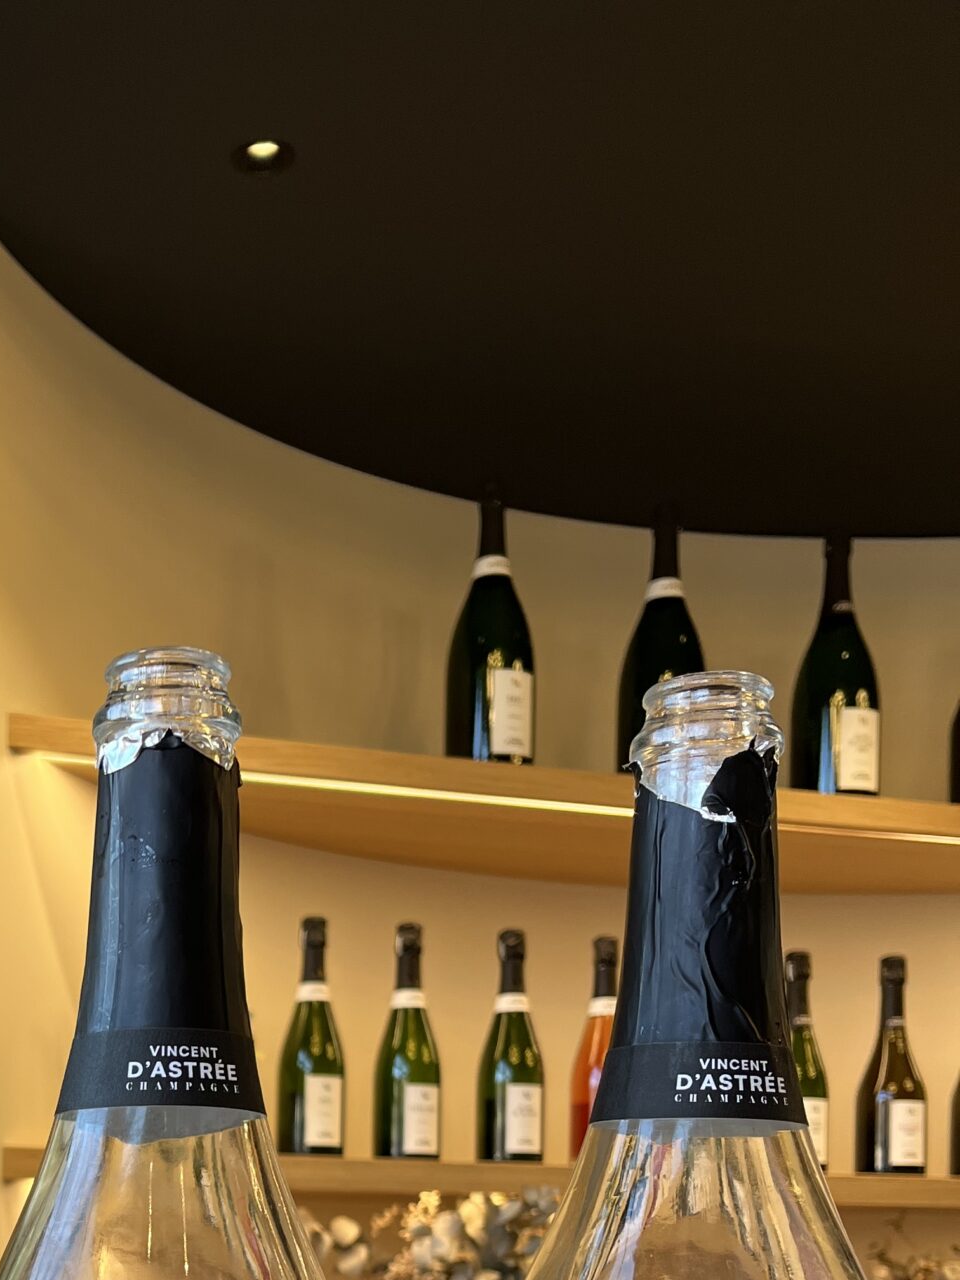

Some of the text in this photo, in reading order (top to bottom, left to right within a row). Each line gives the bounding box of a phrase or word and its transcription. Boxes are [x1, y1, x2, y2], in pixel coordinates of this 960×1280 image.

[149, 1045, 218, 1059] VINCENT
[127, 1059, 238, 1081] D'ASTRÉE
[699, 1058, 768, 1072] VINCENT
[125, 1081, 240, 1094] CHAMPAGNE
[675, 1072, 787, 1093] D'ASTRÉE
[674, 1093, 789, 1106] CHAMPAGNE
